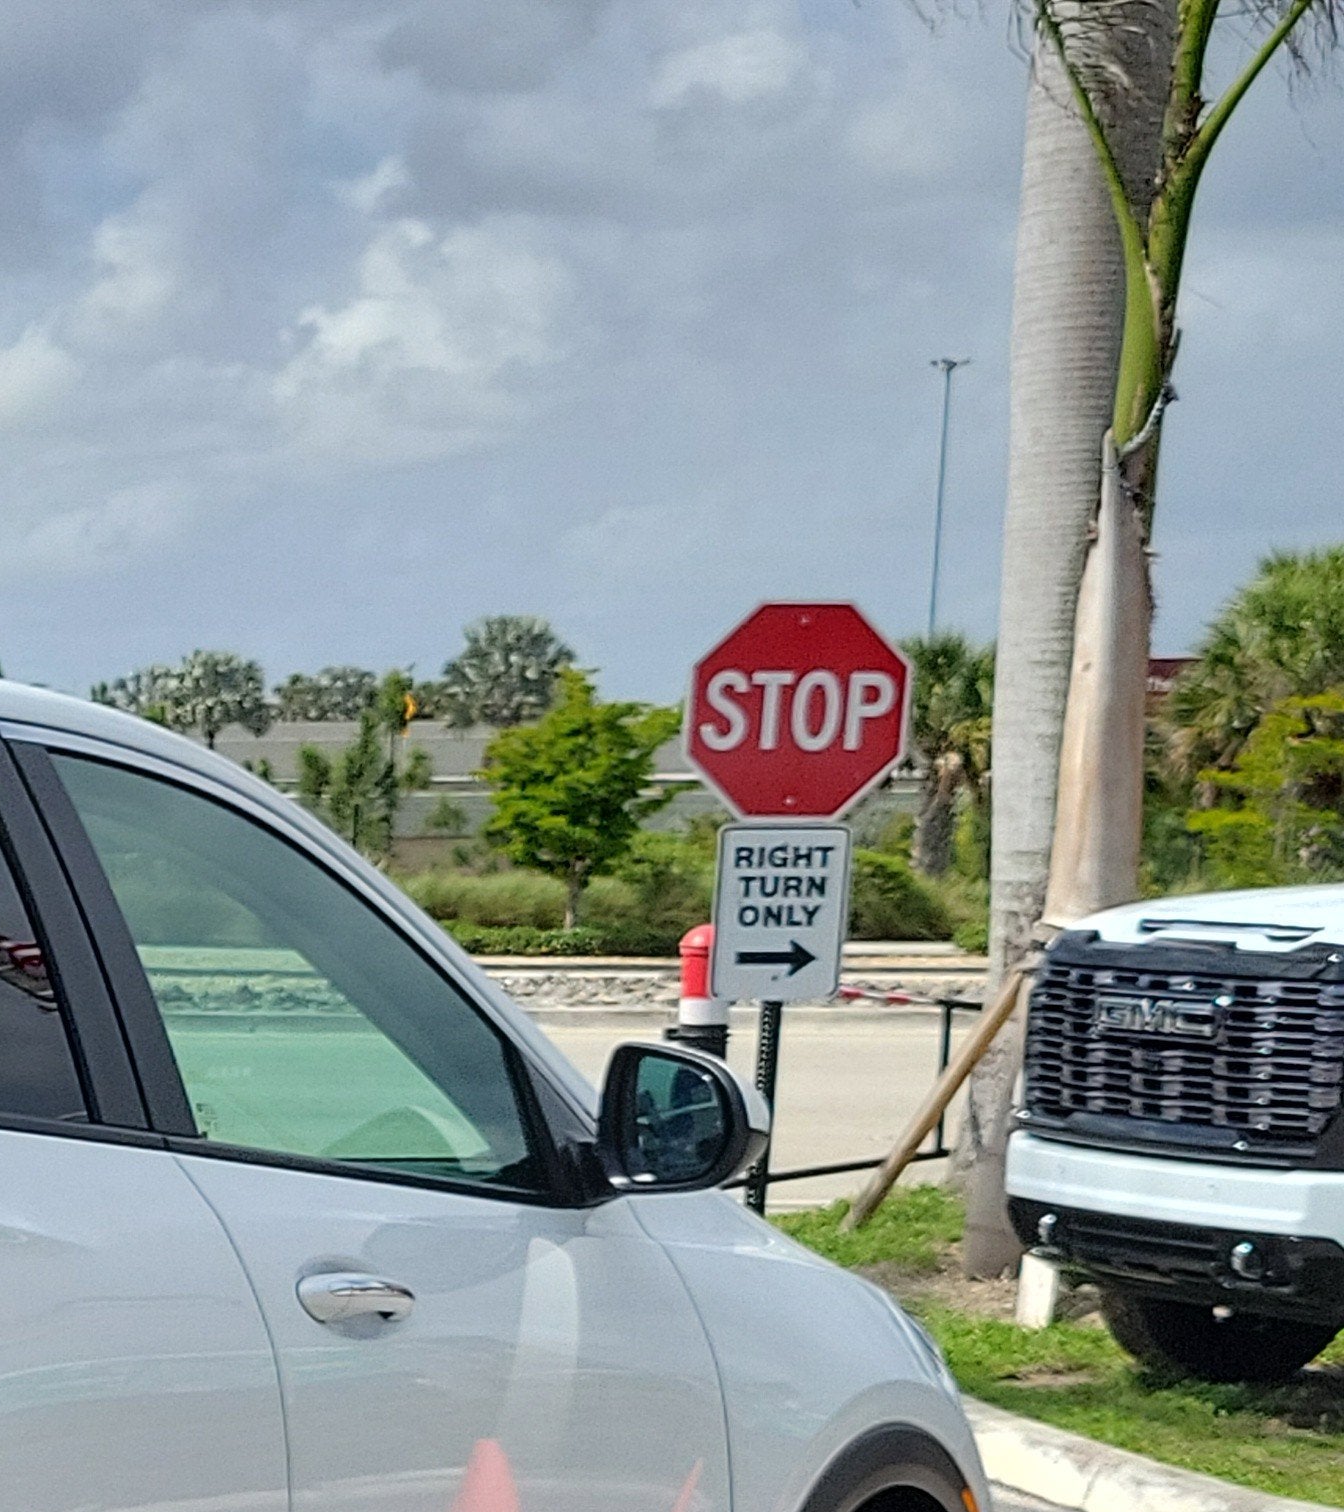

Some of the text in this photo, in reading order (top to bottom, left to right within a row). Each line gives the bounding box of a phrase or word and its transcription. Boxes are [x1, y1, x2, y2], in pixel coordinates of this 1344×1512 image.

[699, 668, 897, 752] STOP
[734, 845, 834, 869] RIGHT
[738, 876, 827, 898] TURN
[738, 905, 822, 927] ONLY
[1097, 998, 1214, 1037] GMC
